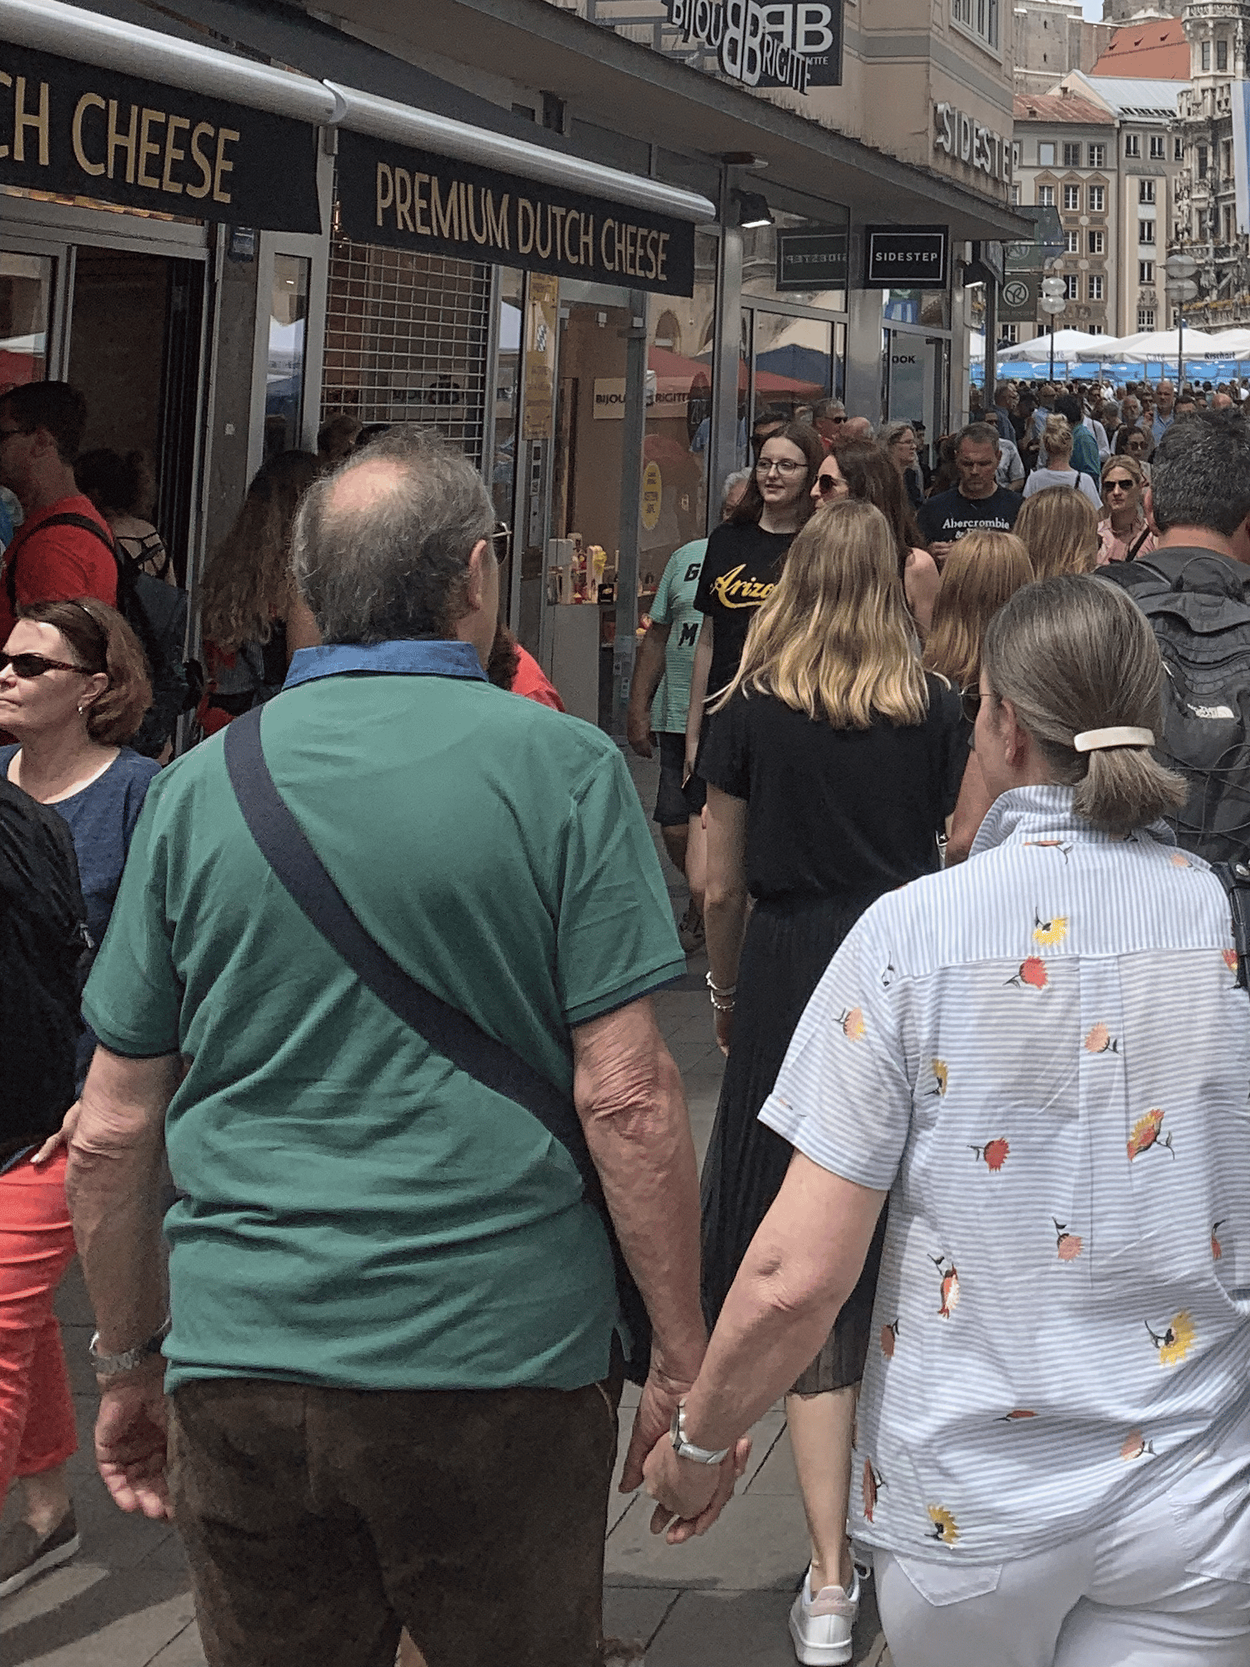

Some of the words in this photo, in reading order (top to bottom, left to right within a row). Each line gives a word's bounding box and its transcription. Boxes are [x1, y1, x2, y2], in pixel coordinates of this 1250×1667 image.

[72, 92, 240, 203] CHEESE
[934, 102, 1020, 184] SIDESTEP
[376, 162, 510, 250] PREMIUM
[518, 197, 594, 267] DUTCH
[601, 218, 670, 281] CHEESE
[875, 252, 938, 262] SIDESTEP
[942, 517, 1010, 530] Abercrombie
[710, 563, 775, 609] Arizo
